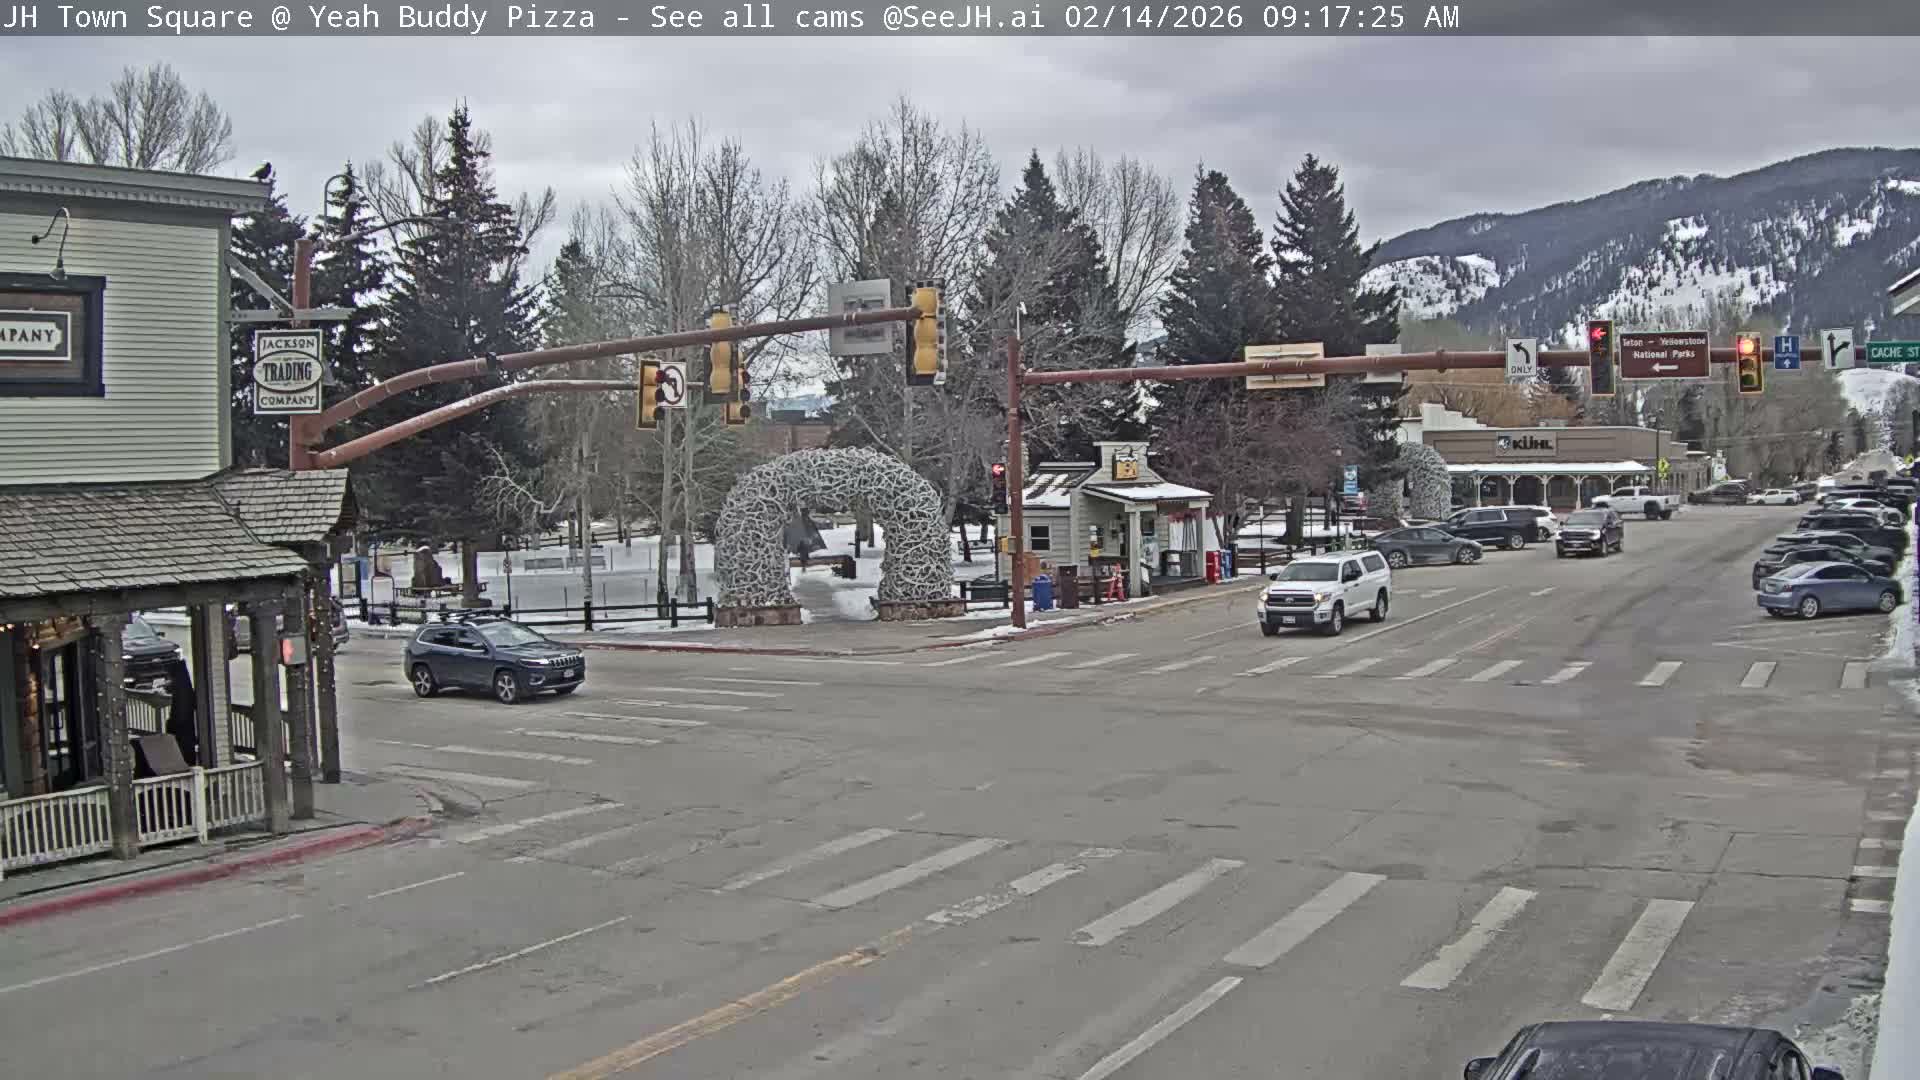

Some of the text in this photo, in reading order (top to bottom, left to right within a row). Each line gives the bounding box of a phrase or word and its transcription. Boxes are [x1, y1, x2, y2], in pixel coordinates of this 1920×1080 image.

[263, 339, 315, 349] JACKSON
[1623, 338, 1643, 346] Teton
[1660, 337, 1706, 346] Yellowstone
[1781, 337, 1792, 352] H
[1633, 349, 1695, 358] National Parks
[1871, 346, 1903, 358] CACHE
[263, 362, 312, 382] TRADING
[1511, 366, 1532, 374] ONLY
[261, 396, 314, 405] COMPANY
[1513, 435, 1553, 450] KÜHL
